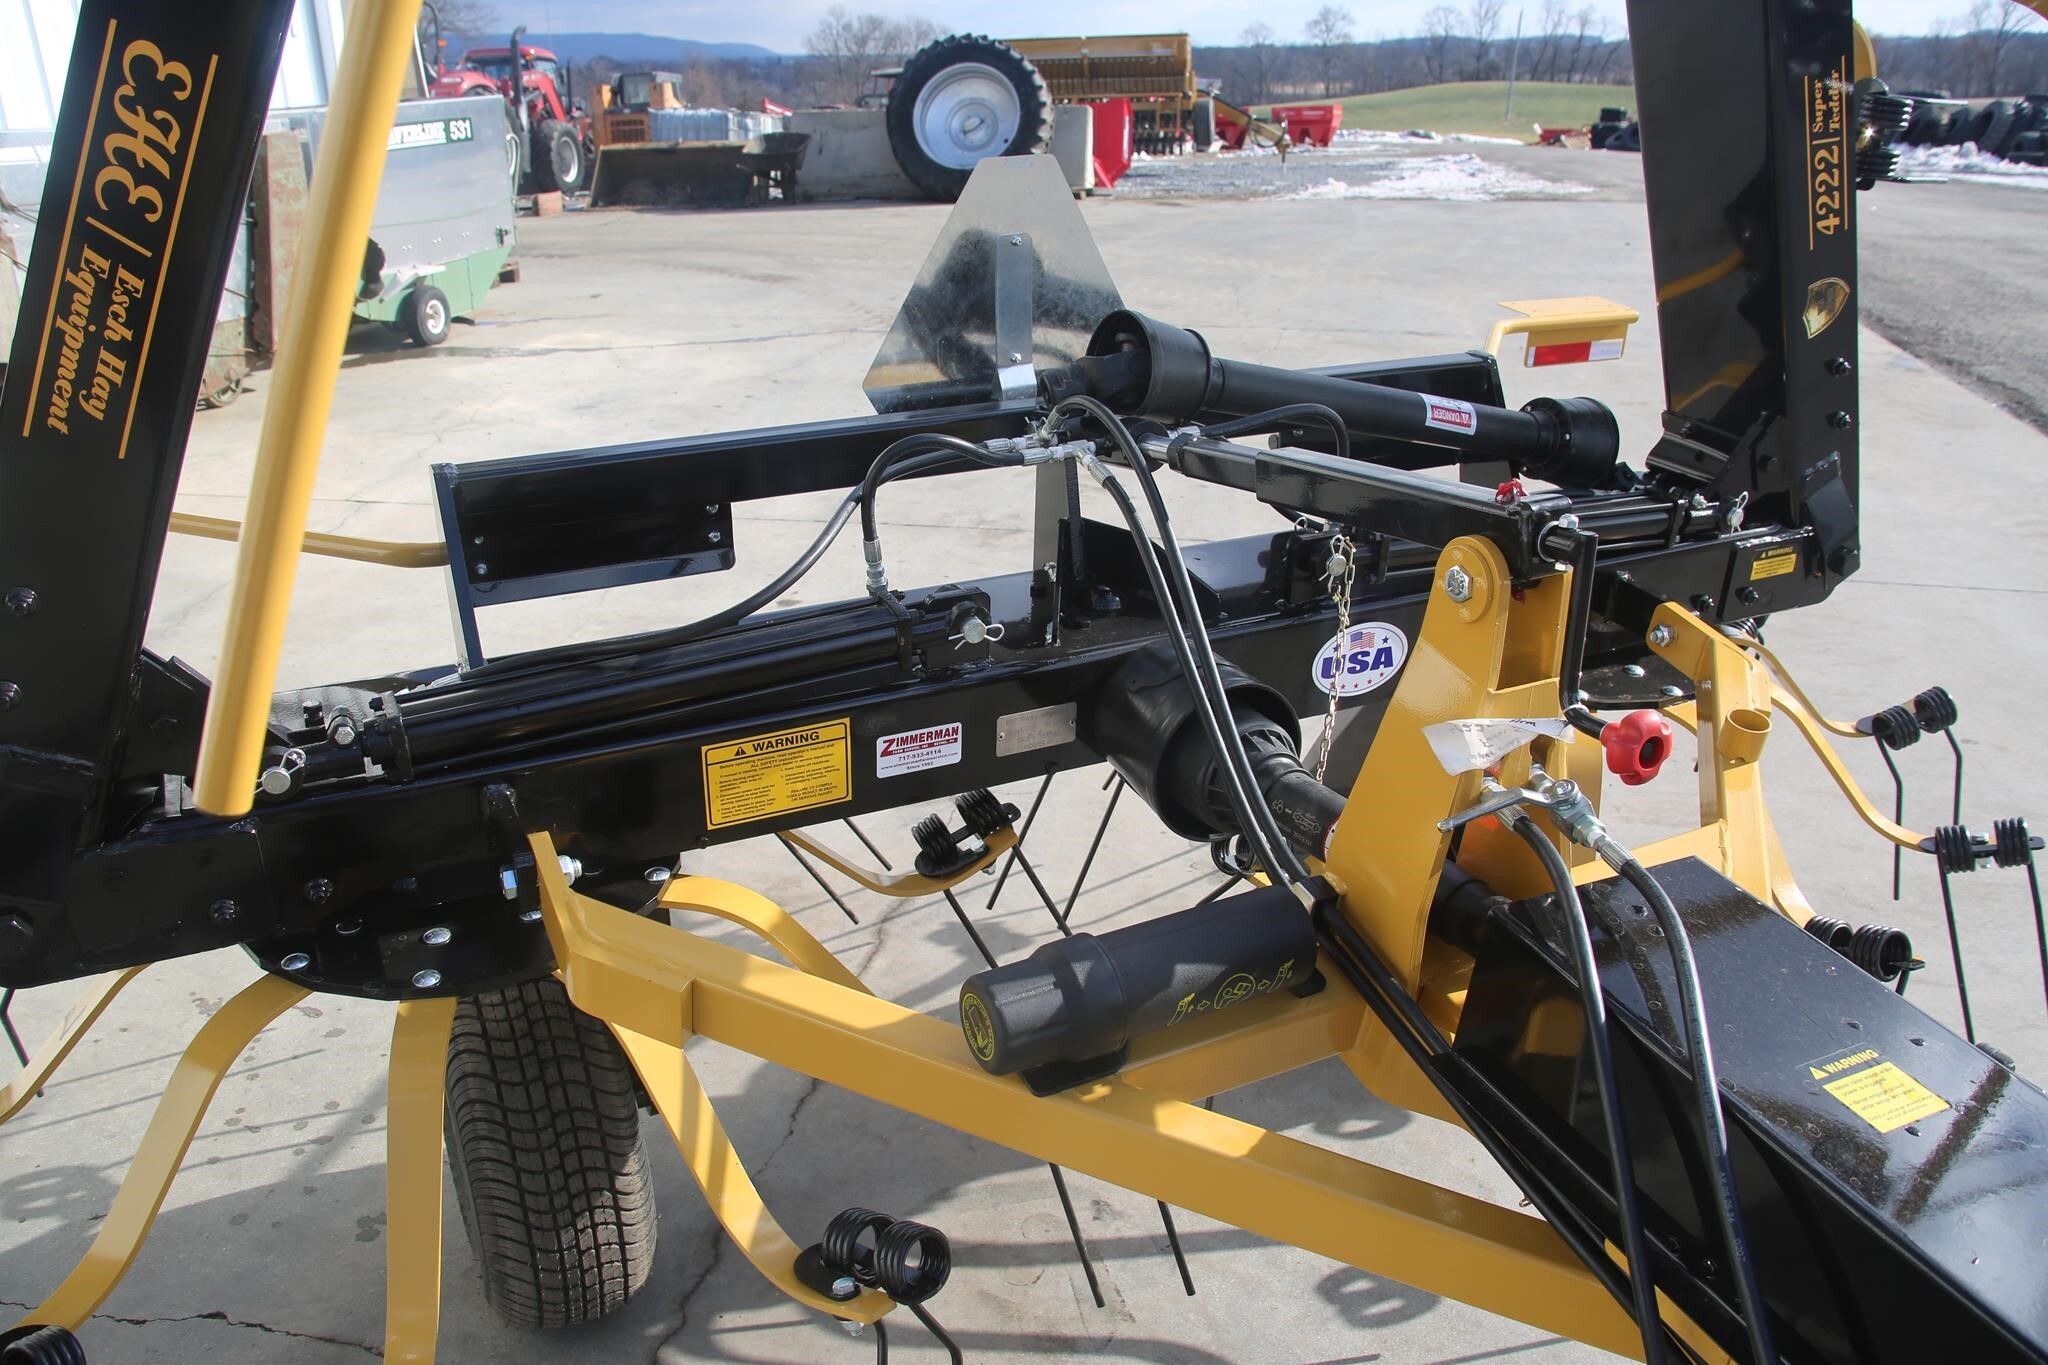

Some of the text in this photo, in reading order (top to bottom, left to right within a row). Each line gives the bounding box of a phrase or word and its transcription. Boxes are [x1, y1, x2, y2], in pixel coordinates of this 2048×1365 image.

[1813, 79, 1827, 133] Super
[449, 119, 472, 140] 531
[1814, 145, 1840, 235] 4222
[48, 243, 111, 435] Equipment
[79, 264, 145, 420] Esch Hay
[1433, 408, 1460, 422] DANGER
[1321, 646, 1393, 679] USA
[752, 731, 820, 753] WARNING
[880, 726, 959, 757] ZIMMERMAN
[1822, 1049, 1880, 1073] WARNING
